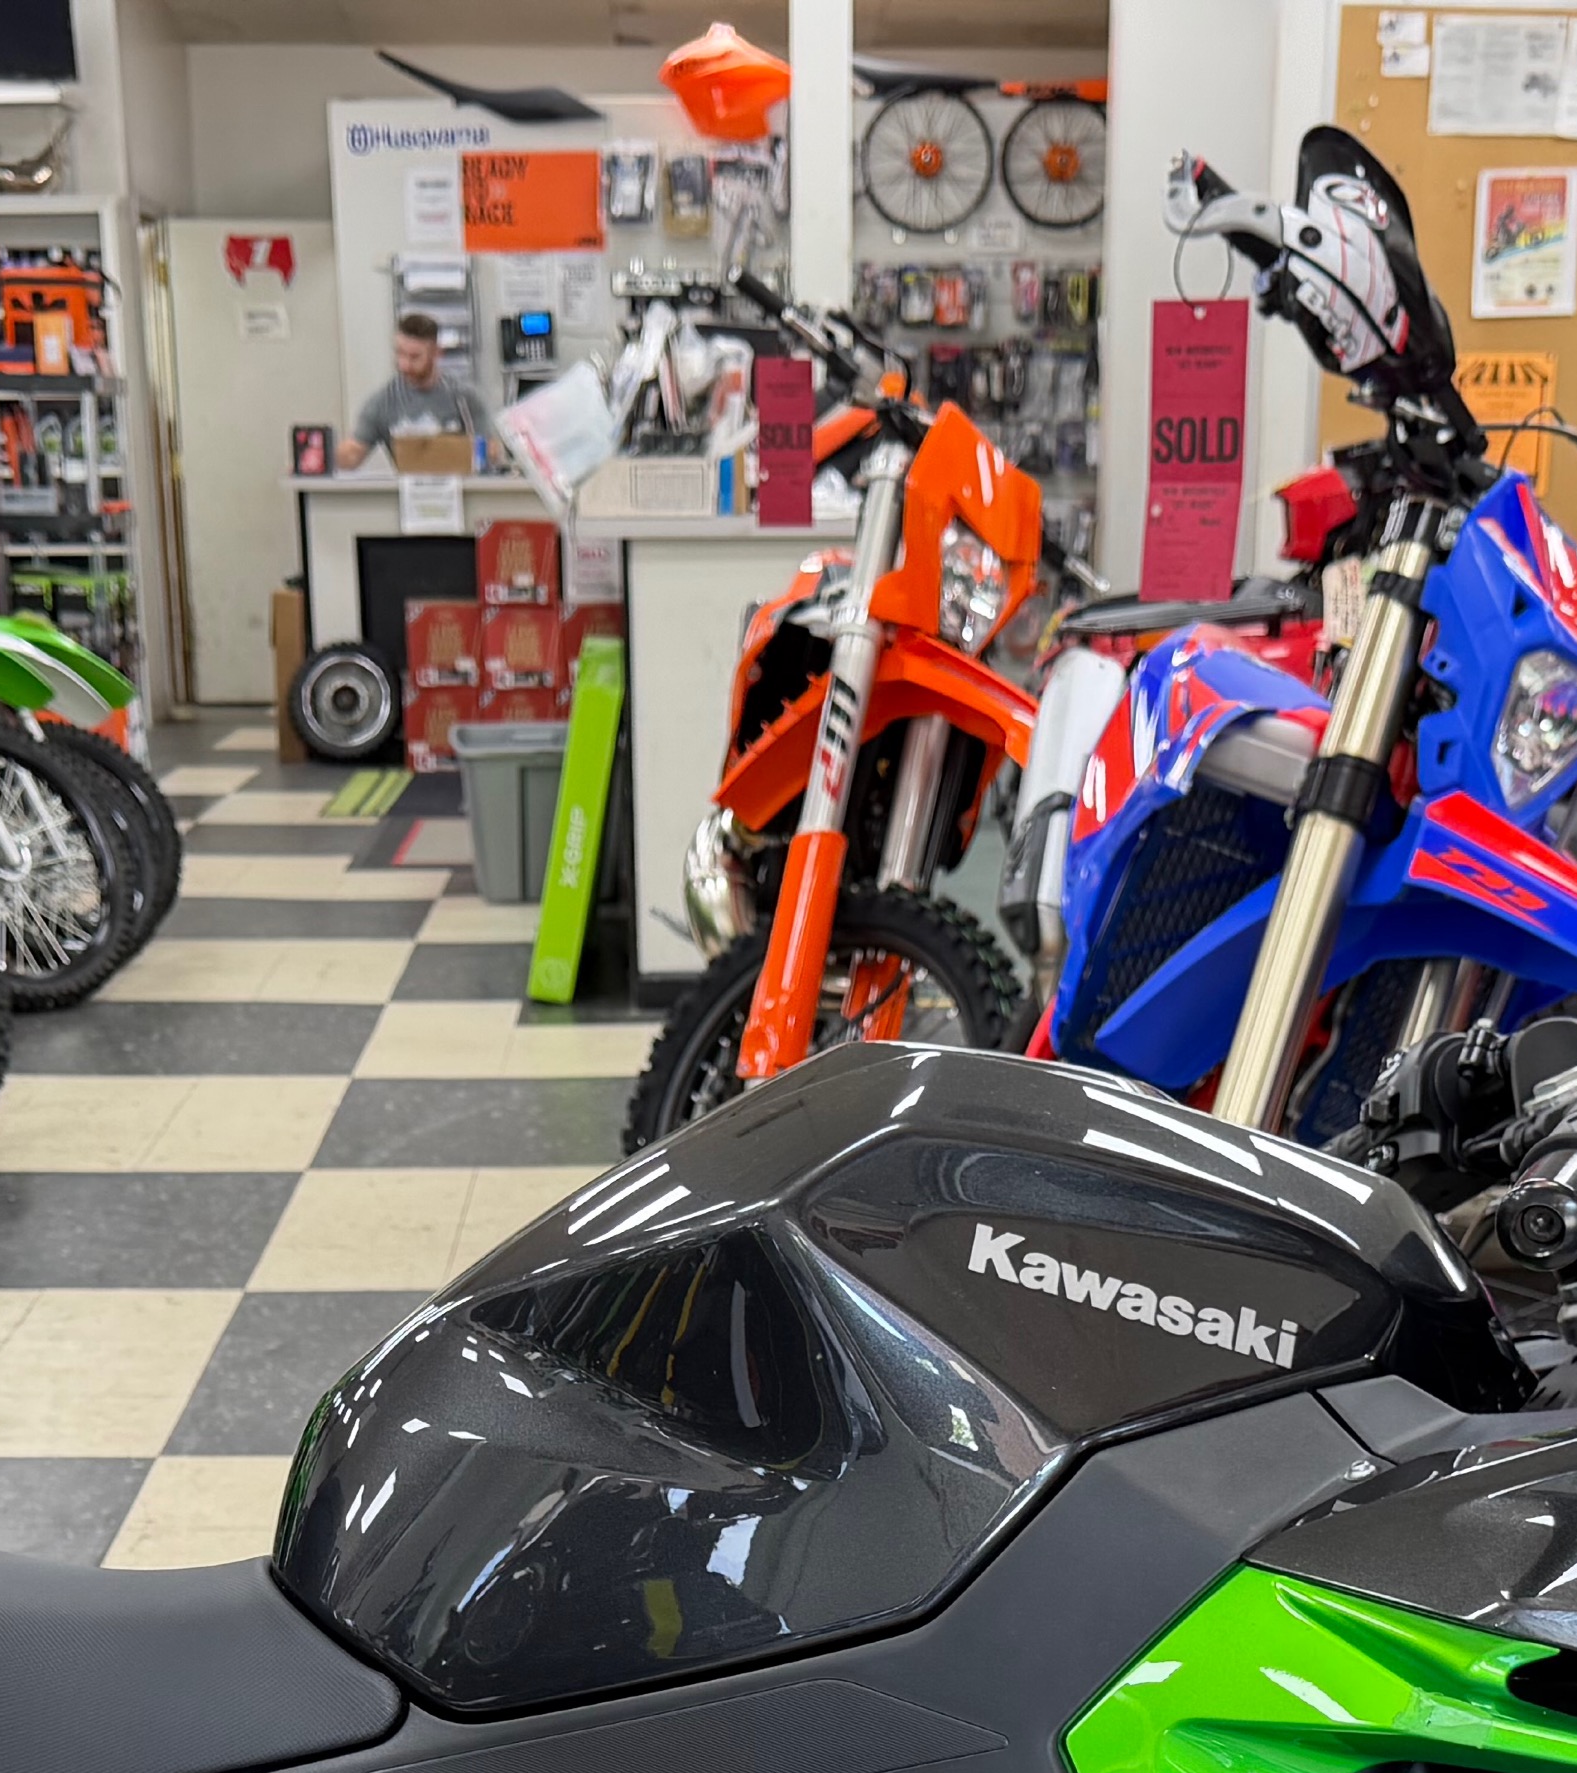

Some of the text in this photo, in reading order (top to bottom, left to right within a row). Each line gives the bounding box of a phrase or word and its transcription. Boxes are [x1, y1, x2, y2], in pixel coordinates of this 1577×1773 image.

[759, 422, 813, 451] SOLD
[1154, 416, 1241, 464] SOLD
[968, 1222, 1300, 1370] Kawasaki
